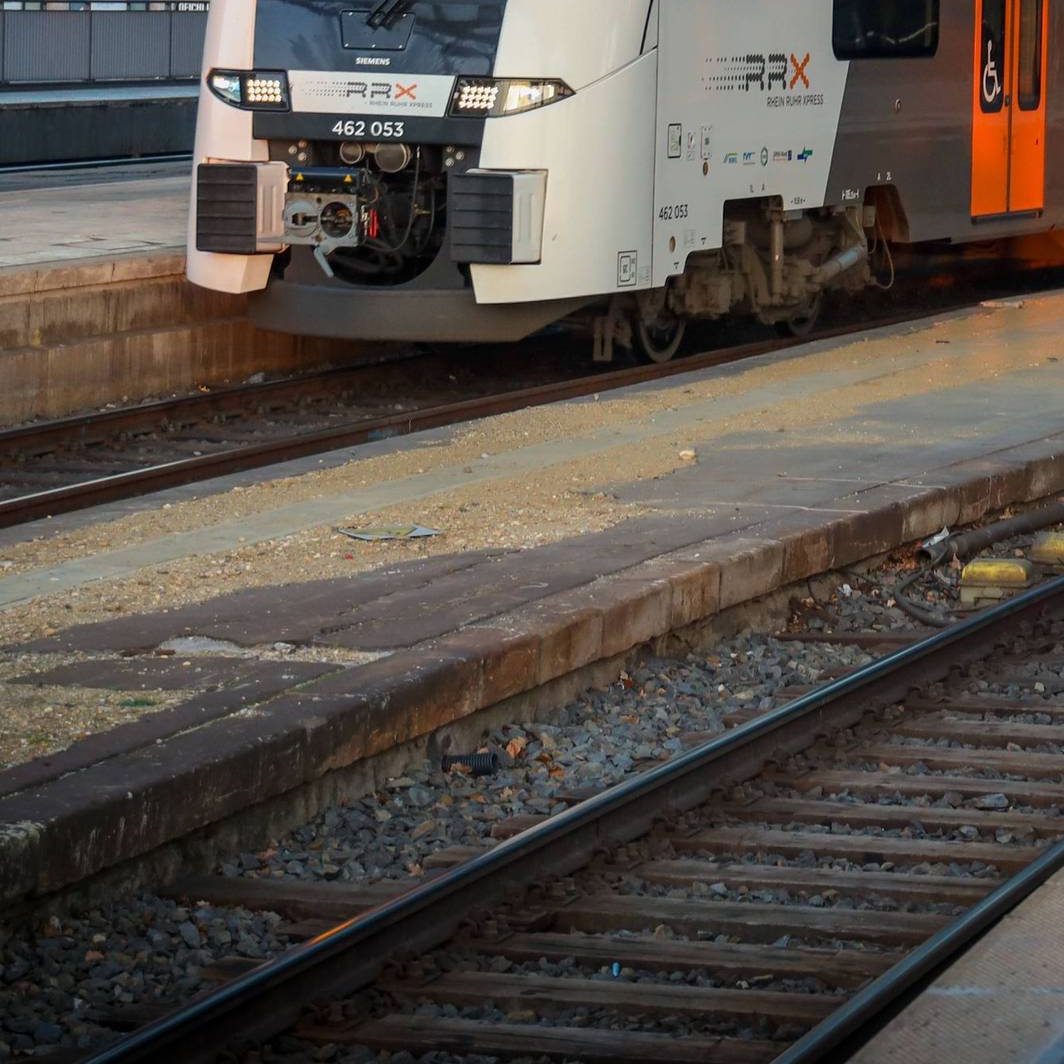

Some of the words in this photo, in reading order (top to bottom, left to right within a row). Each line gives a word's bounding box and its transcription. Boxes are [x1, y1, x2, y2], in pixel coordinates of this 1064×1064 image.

[355, 57, 390, 66] SIEMENS
[732, 53, 809, 91] RRX
[330, 80, 417, 100] RRX
[766, 96, 785, 107] RHEIN
[785, 95, 801, 107] RUHR
[802, 94, 824, 106] XPRESS
[332, 120, 366, 136] 462
[370, 121, 404, 137] 053
[658, 206, 673, 221] 462
[674, 203, 689, 219] 053
